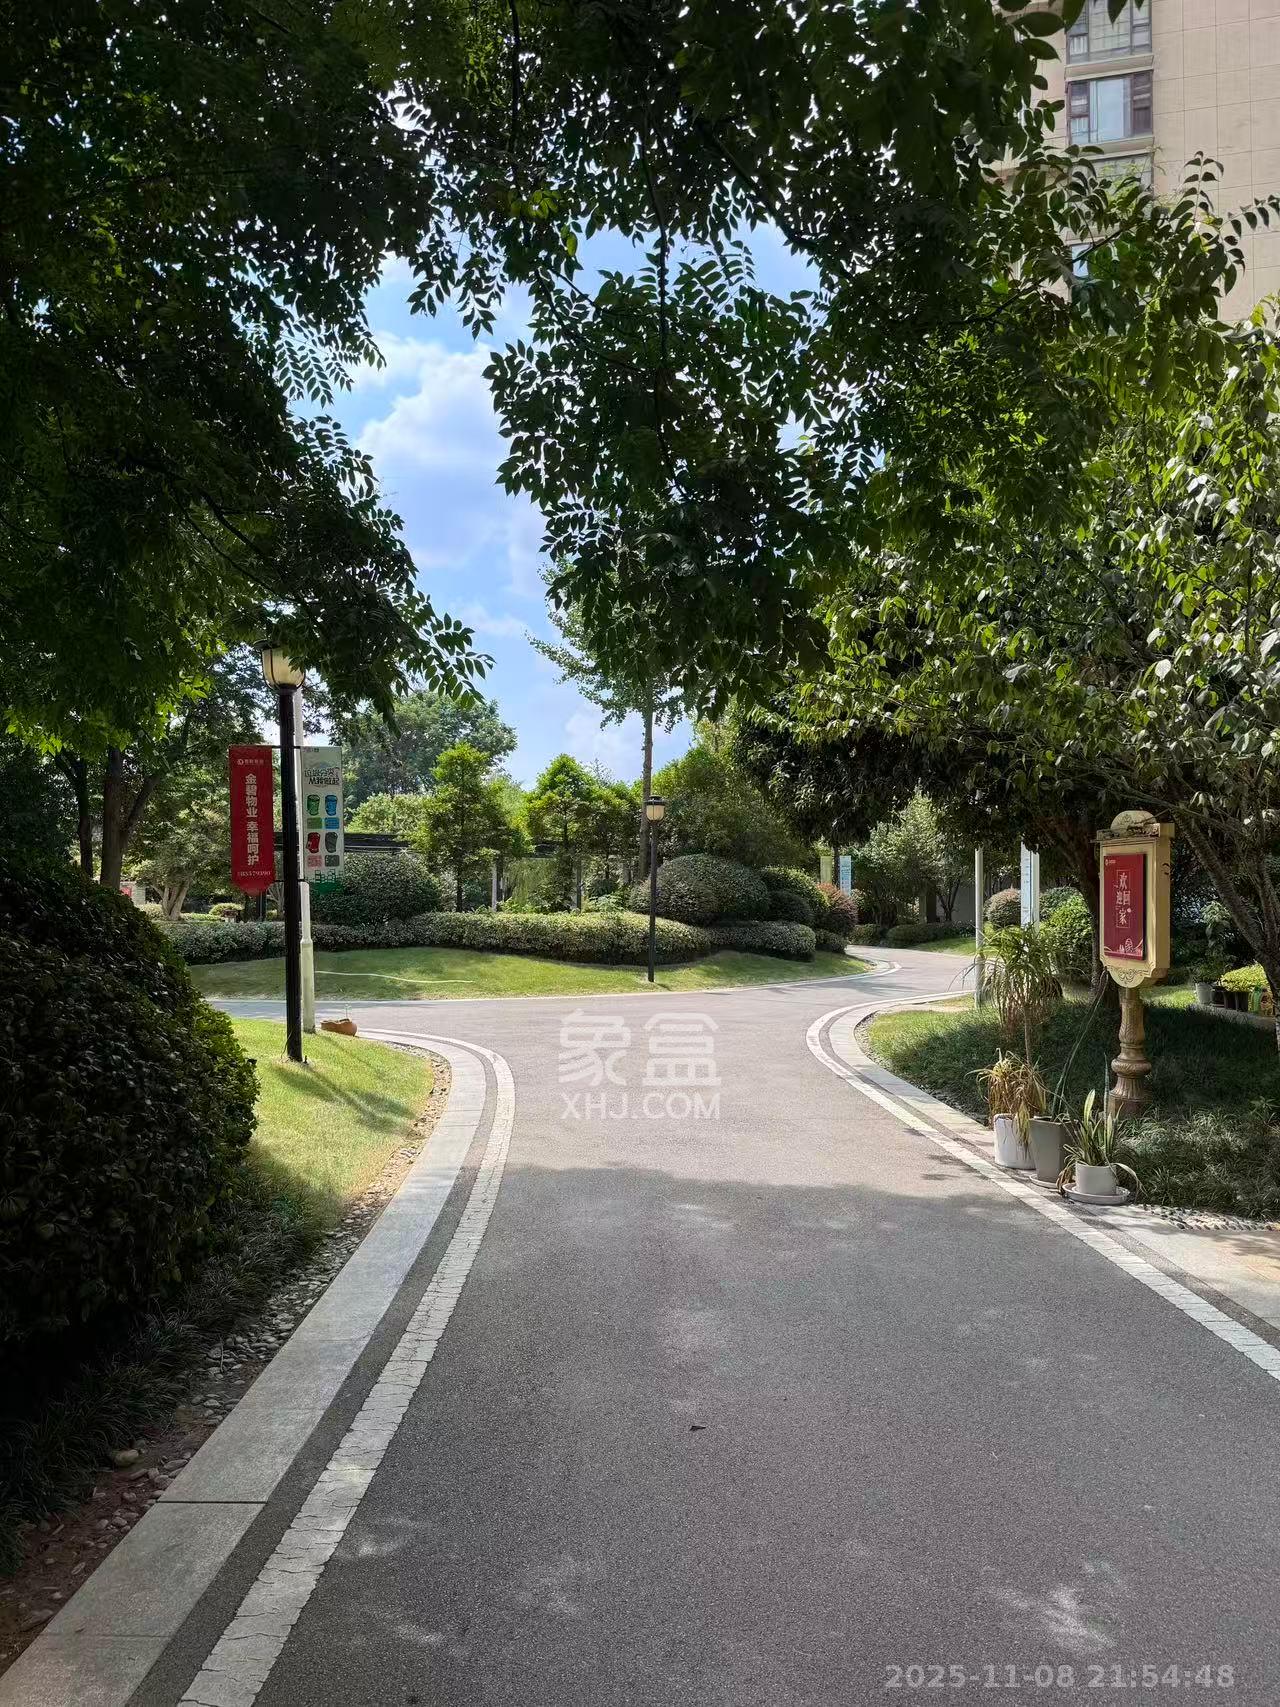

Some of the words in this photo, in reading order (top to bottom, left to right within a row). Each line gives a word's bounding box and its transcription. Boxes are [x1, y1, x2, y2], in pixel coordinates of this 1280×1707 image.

[244, 773, 258, 818] 金碧物业
[246, 821, 260, 866] 幸福呵护
[1116, 872, 1131, 925] 欢迎回家
